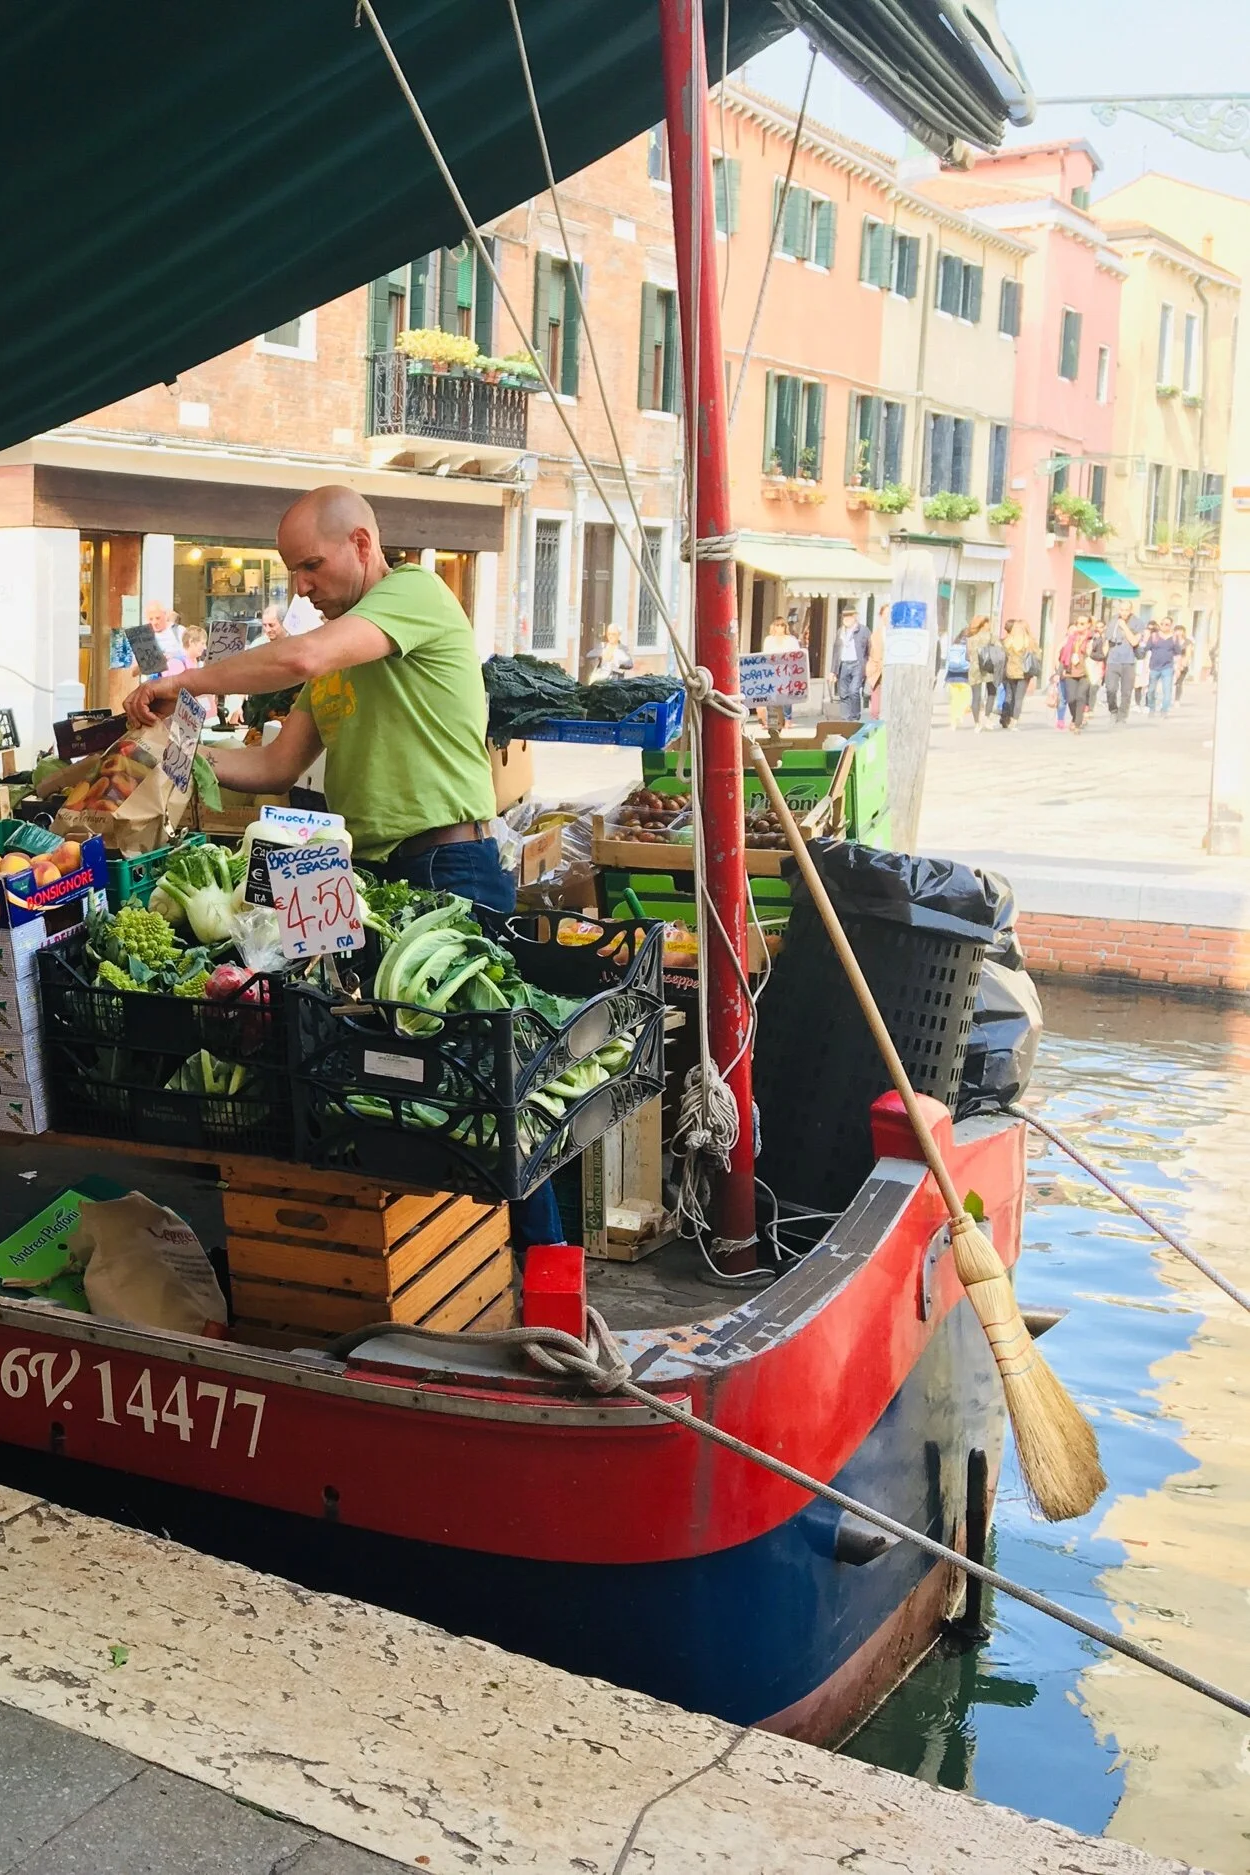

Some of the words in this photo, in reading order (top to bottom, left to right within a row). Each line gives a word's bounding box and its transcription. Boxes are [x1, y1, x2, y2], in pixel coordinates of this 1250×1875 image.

[264, 806, 332, 827] Finocchio
[267, 846, 340, 870] BROCCOLO
[296, 857, 349, 876] ERASMO
[26, 867, 95, 911] BONSIGNORE
[9, 1233, 47, 1267] Andrea
[41, 1209, 81, 1243] Plafoni
[92, 1360, 266, 1458] 14477
